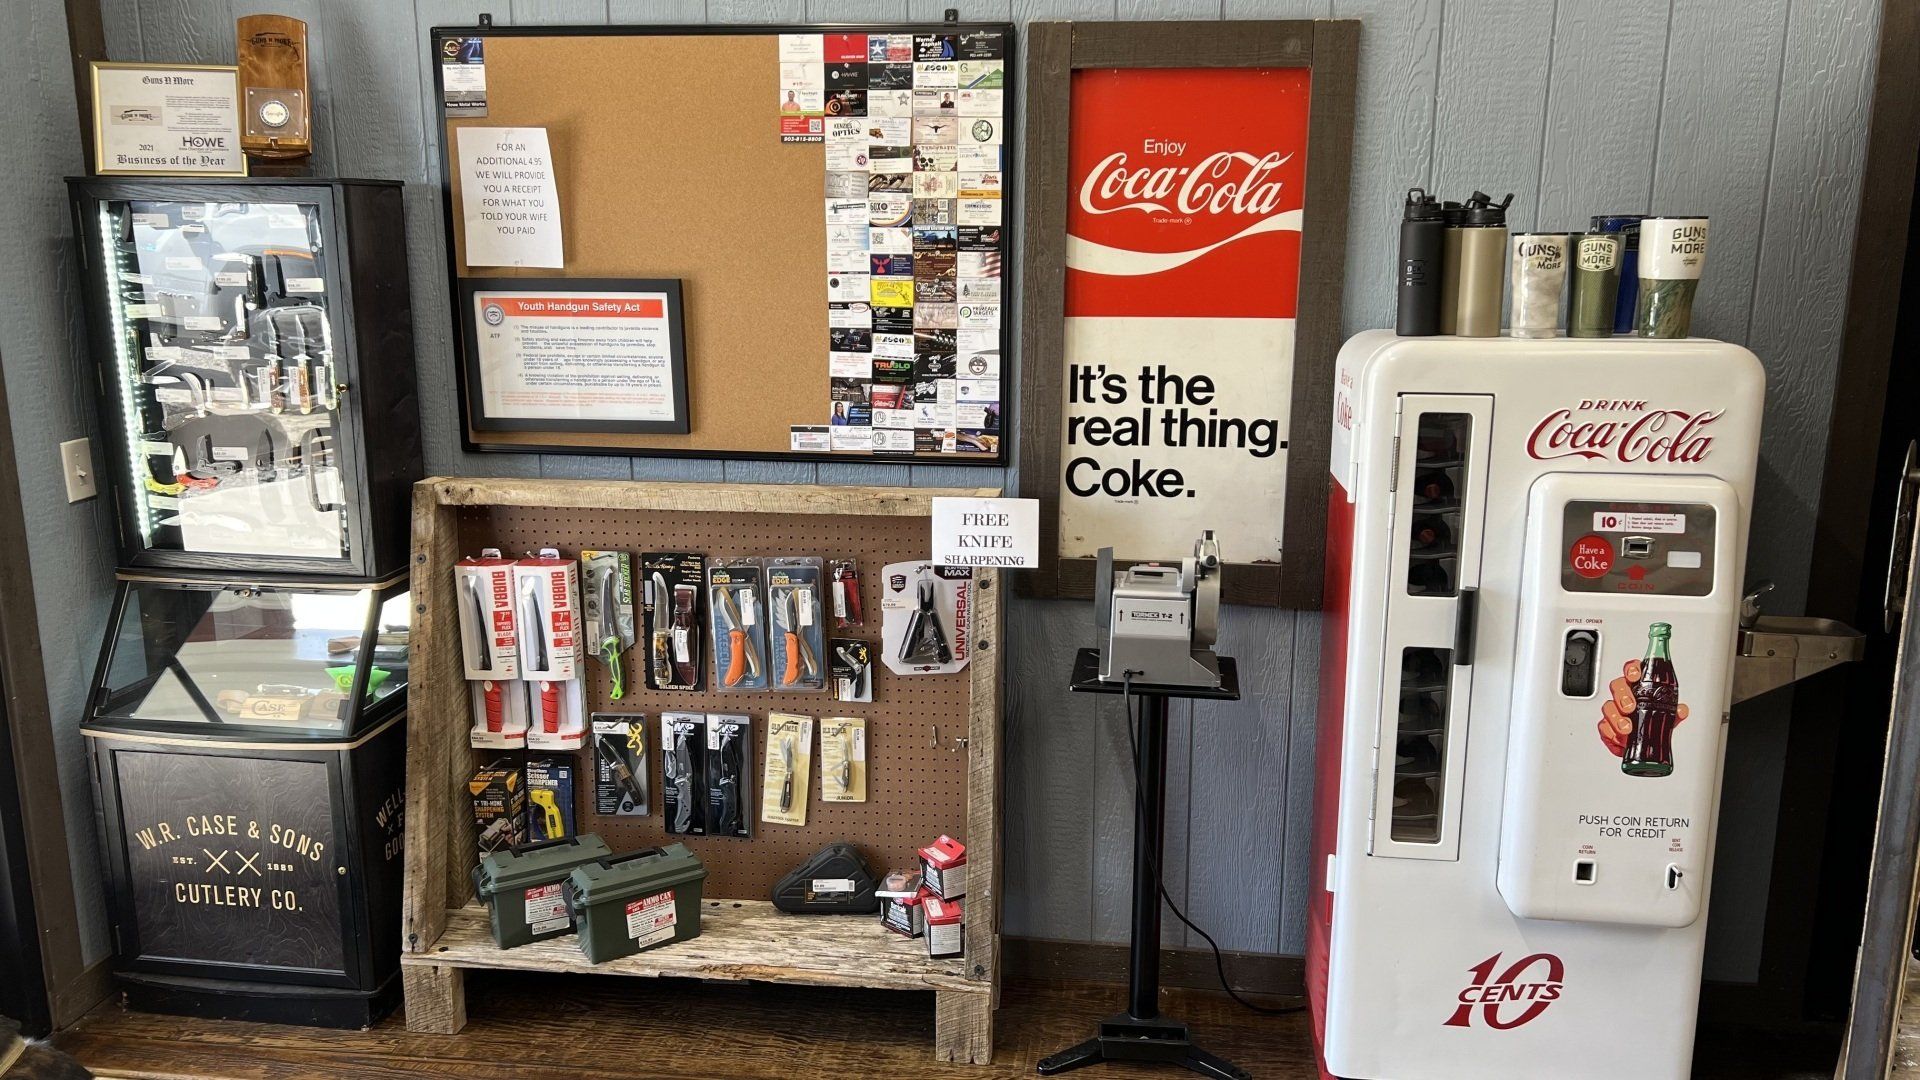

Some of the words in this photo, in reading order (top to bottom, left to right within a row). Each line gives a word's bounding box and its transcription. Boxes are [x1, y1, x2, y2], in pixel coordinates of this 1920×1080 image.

[142, 76, 163, 85] Guns
[173, 77, 194, 86] More
[832, 128, 860, 138] OPTICS
[182, 136, 225, 148] HOWE
[496, 143, 513, 152] FOR
[515, 144, 526, 152] AN
[1144, 138, 1187, 156] Enjoy
[117, 154, 167, 165] Business
[170, 155, 179, 165] of
[181, 156, 197, 165] the
[200, 155, 226, 167] Year
[476, 157, 527, 166] ADDITIONAL
[476, 171, 490, 179] WE
[492, 171, 512, 180] WILL
[514, 171, 546, 180] PROVIDE
[1079, 151, 1294, 215] Coca-Cola
[483, 185, 502, 193] YOU
[504, 185, 510, 193] A
[512, 185, 542, 194] RECEIPT
[482, 198, 500, 206] FOR
[502, 198, 526, 207] WHAT
[529, 199, 544, 208] YOU
[481, 212, 503, 220] TOLD
[505, 212, 528, 221] YOUR
[530, 213, 548, 222] WIFE
[497, 226, 515, 234] YOU
[517, 226, 536, 234] PAID
[1672, 226, 1706, 240] GUNS
[1583, 242, 1613, 253] GUNS
[1671, 243, 1705, 254] MORE
[1582, 255, 1611, 266] MORE
[518, 302, 544, 310] Youth
[547, 302, 590, 312] Handgun
[592, 303, 622, 312] Safety
[625, 304, 640, 312] Act
[1070, 364, 1128, 404] It's
[1138, 365, 1215, 406] the
[1337, 391, 1352, 431] Coke
[1578, 400, 1647, 411] DRINK
[1068, 407, 1151, 447] real
[1160, 408, 1288, 458] thing.
[1526, 408, 1726, 463] Coca-Cola
[1065, 456, 1196, 498] Coke.
[962, 513, 1009, 526] FREE
[1602, 516, 1616, 528] 10
[958, 535, 1012, 548] KNIFE
[1580, 544, 1598, 555] Have
[1599, 547, 1605, 555] a
[945, 555, 1024, 566] SHARPENING
[1574, 555, 1608, 570] Coke
[492, 571, 508, 608] BUBBA
[551, 572, 567, 608] BUBBA
[955, 581, 967, 661] UNIVERSAL
[574, 617, 582, 664] LIFESTYLE
[1579, 815, 1608, 824] PUSH
[1613, 816, 1640, 826] COIN
[1645, 817, 1690, 827] RETURN
[136, 822, 180, 850] W.R.
[186, 815, 238, 836] CASE
[248, 820, 260, 839] &
[270, 824, 324, 860] SONS
[1600, 827, 1621, 836] FOR
[1627, 828, 1666, 838] CREDIT
[172, 856, 197, 864] EST.
[176, 883, 261, 907] CUTLERY
[272, 889, 302, 911] CO.
[643, 895, 660, 906] AMMO
[1442, 951, 1564, 1030] 10
[1458, 984, 1563, 1002] CENTS
